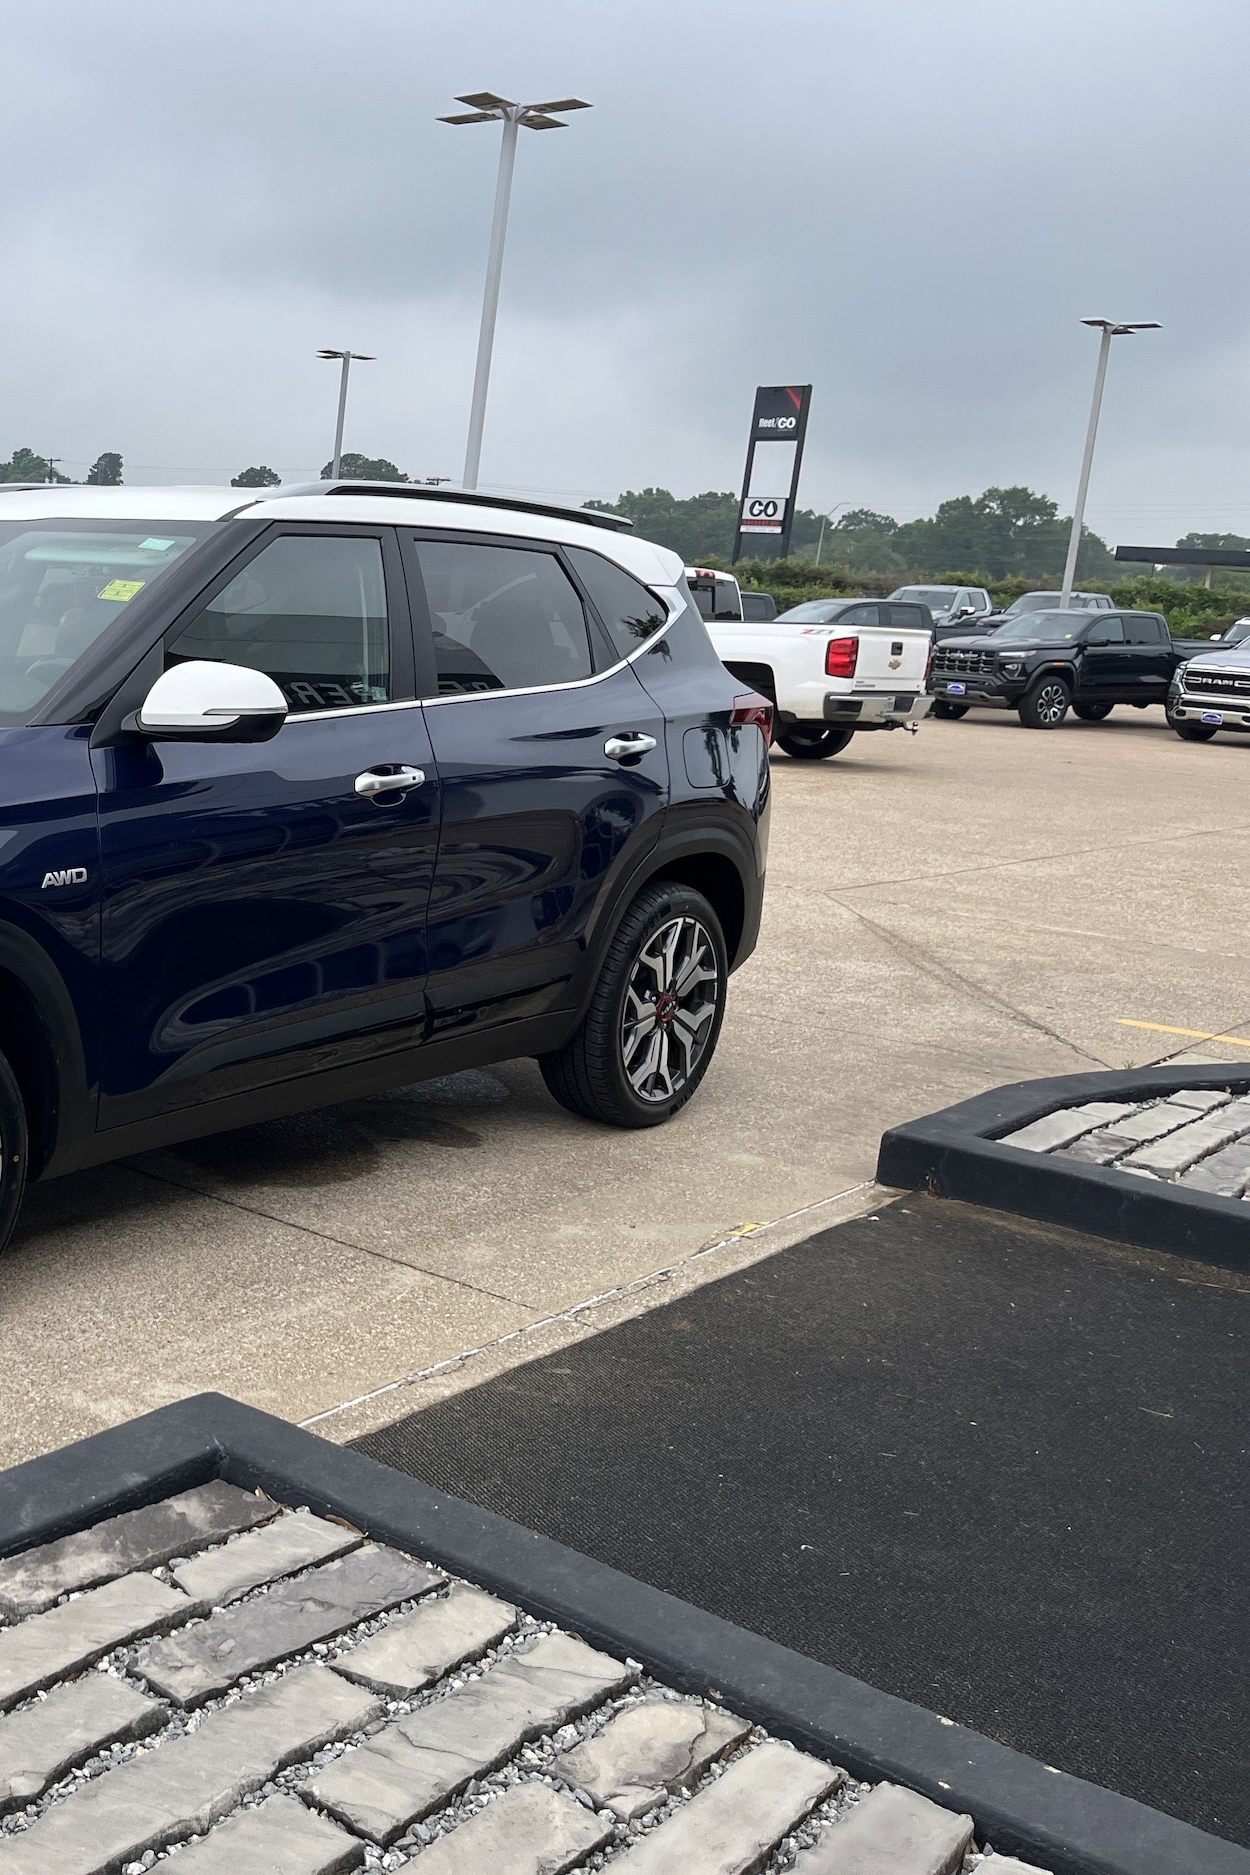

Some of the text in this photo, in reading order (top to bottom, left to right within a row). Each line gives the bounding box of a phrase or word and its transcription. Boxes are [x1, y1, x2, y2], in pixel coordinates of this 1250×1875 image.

[749, 500, 778, 517] GO
[1202, 677, 1233, 686] RAM
[41, 867, 88, 889] AWD
